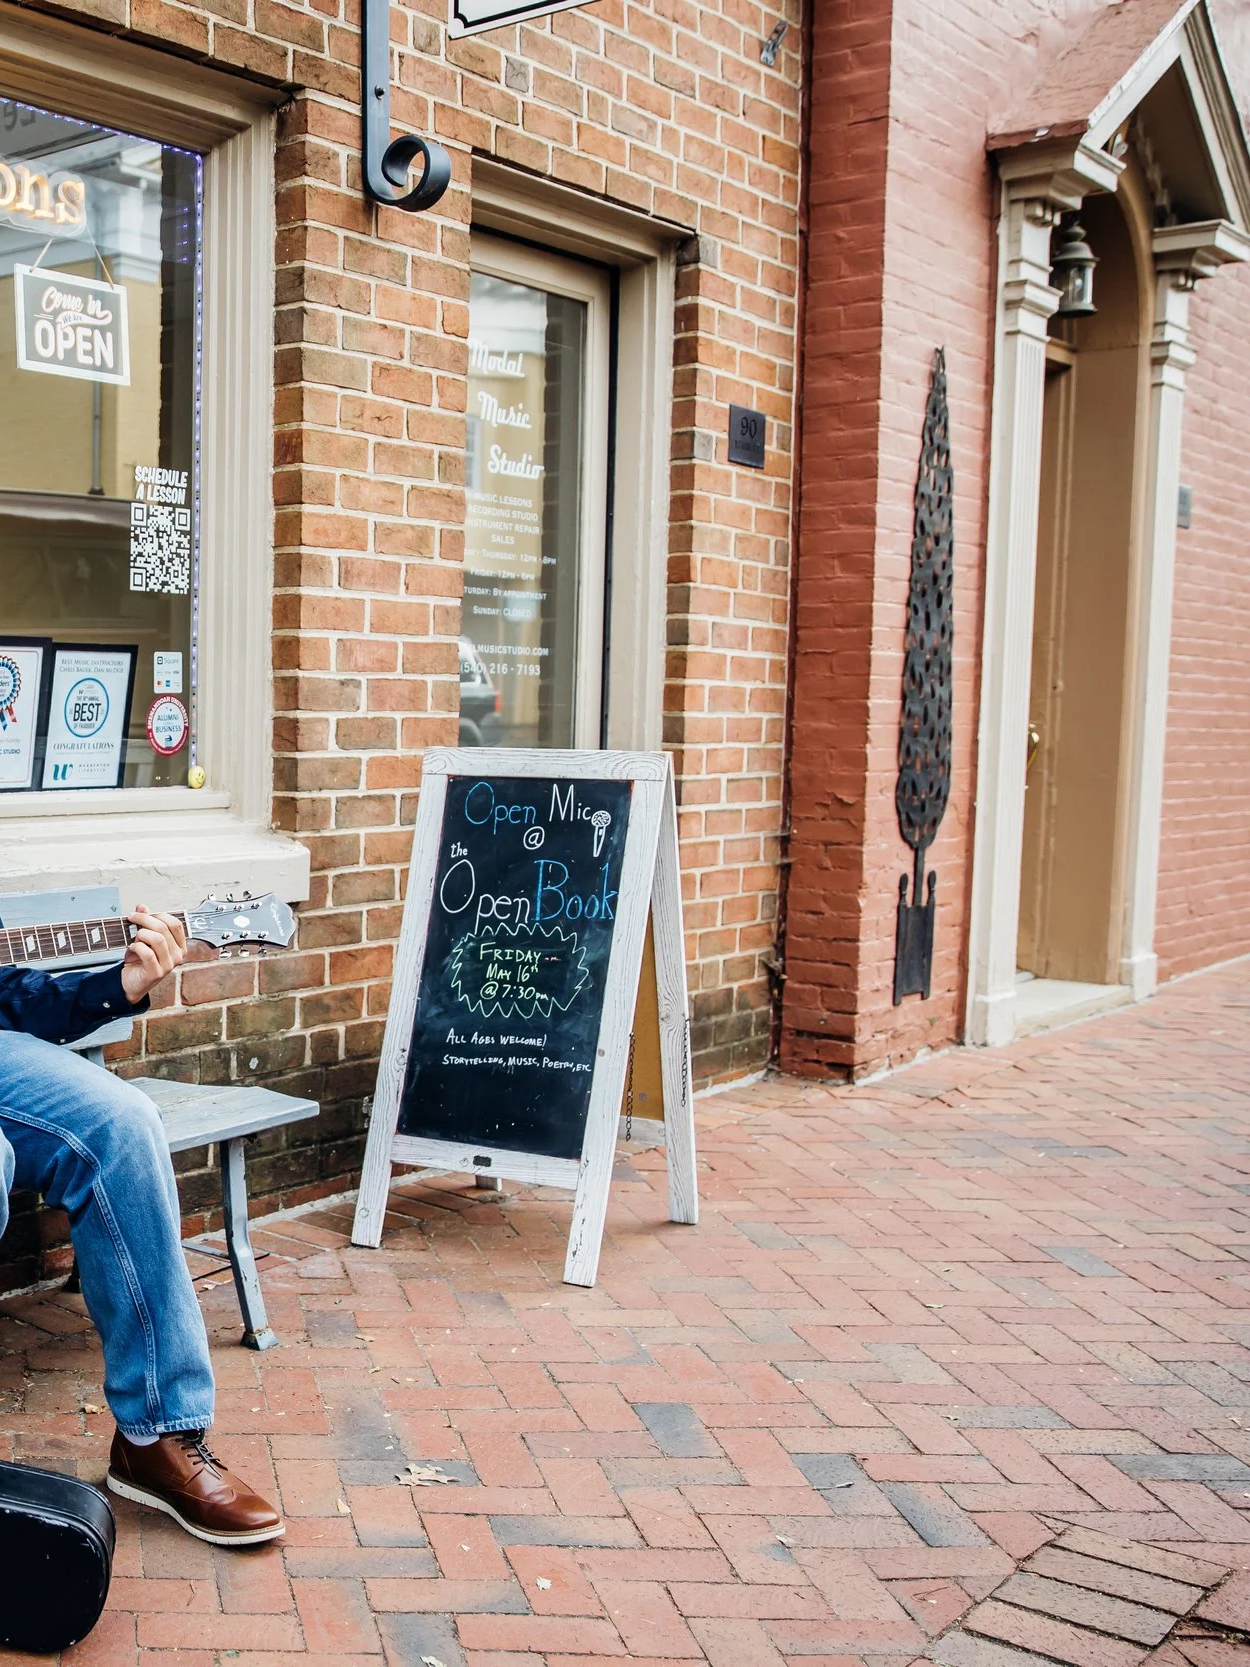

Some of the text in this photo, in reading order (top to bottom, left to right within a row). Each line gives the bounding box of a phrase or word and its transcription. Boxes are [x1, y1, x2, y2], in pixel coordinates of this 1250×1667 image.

[41, 286, 84, 314] Come
[34, 319, 114, 368] OPEN
[468, 341, 526, 378] Modal
[477, 390, 532, 429] Music
[740, 416, 758, 439] 90
[487, 443, 545, 480] Studio
[134, 465, 189, 488] SCHEDULE
[136, 482, 186, 505] A LESSON
[473, 492, 533, 508] MUSIC LESSONS
[467, 503, 539, 522] RECORDING STUDIO
[513, 524, 540, 535] REPAIR
[491, 534, 515, 545] SALES
[464, 586, 491, 596] TURDAY:
[502, 607, 532, 617] CLOSED
[472, 644, 549, 656] LMUSICSTUDIO.COM
[489, 662, 508, 674] 216
[517, 663, 541, 676] 7193
[73, 703, 102, 721] BEST
[157, 714, 179, 722] ALUMNI
[155, 724, 182, 733] BUSINESS
[53, 742, 115, 750] CONGRATULATIONS
[464, 781, 592, 835] Open Mic
[523, 825, 546, 850] @
[450, 842, 468, 858] the
[440, 859, 620, 935] Open Book
[479, 941, 542, 963] FRIDAY
[480, 981, 499, 1000] @
[445, 1027, 467, 1045] ALL
[470, 1031, 496, 1045] AGES
